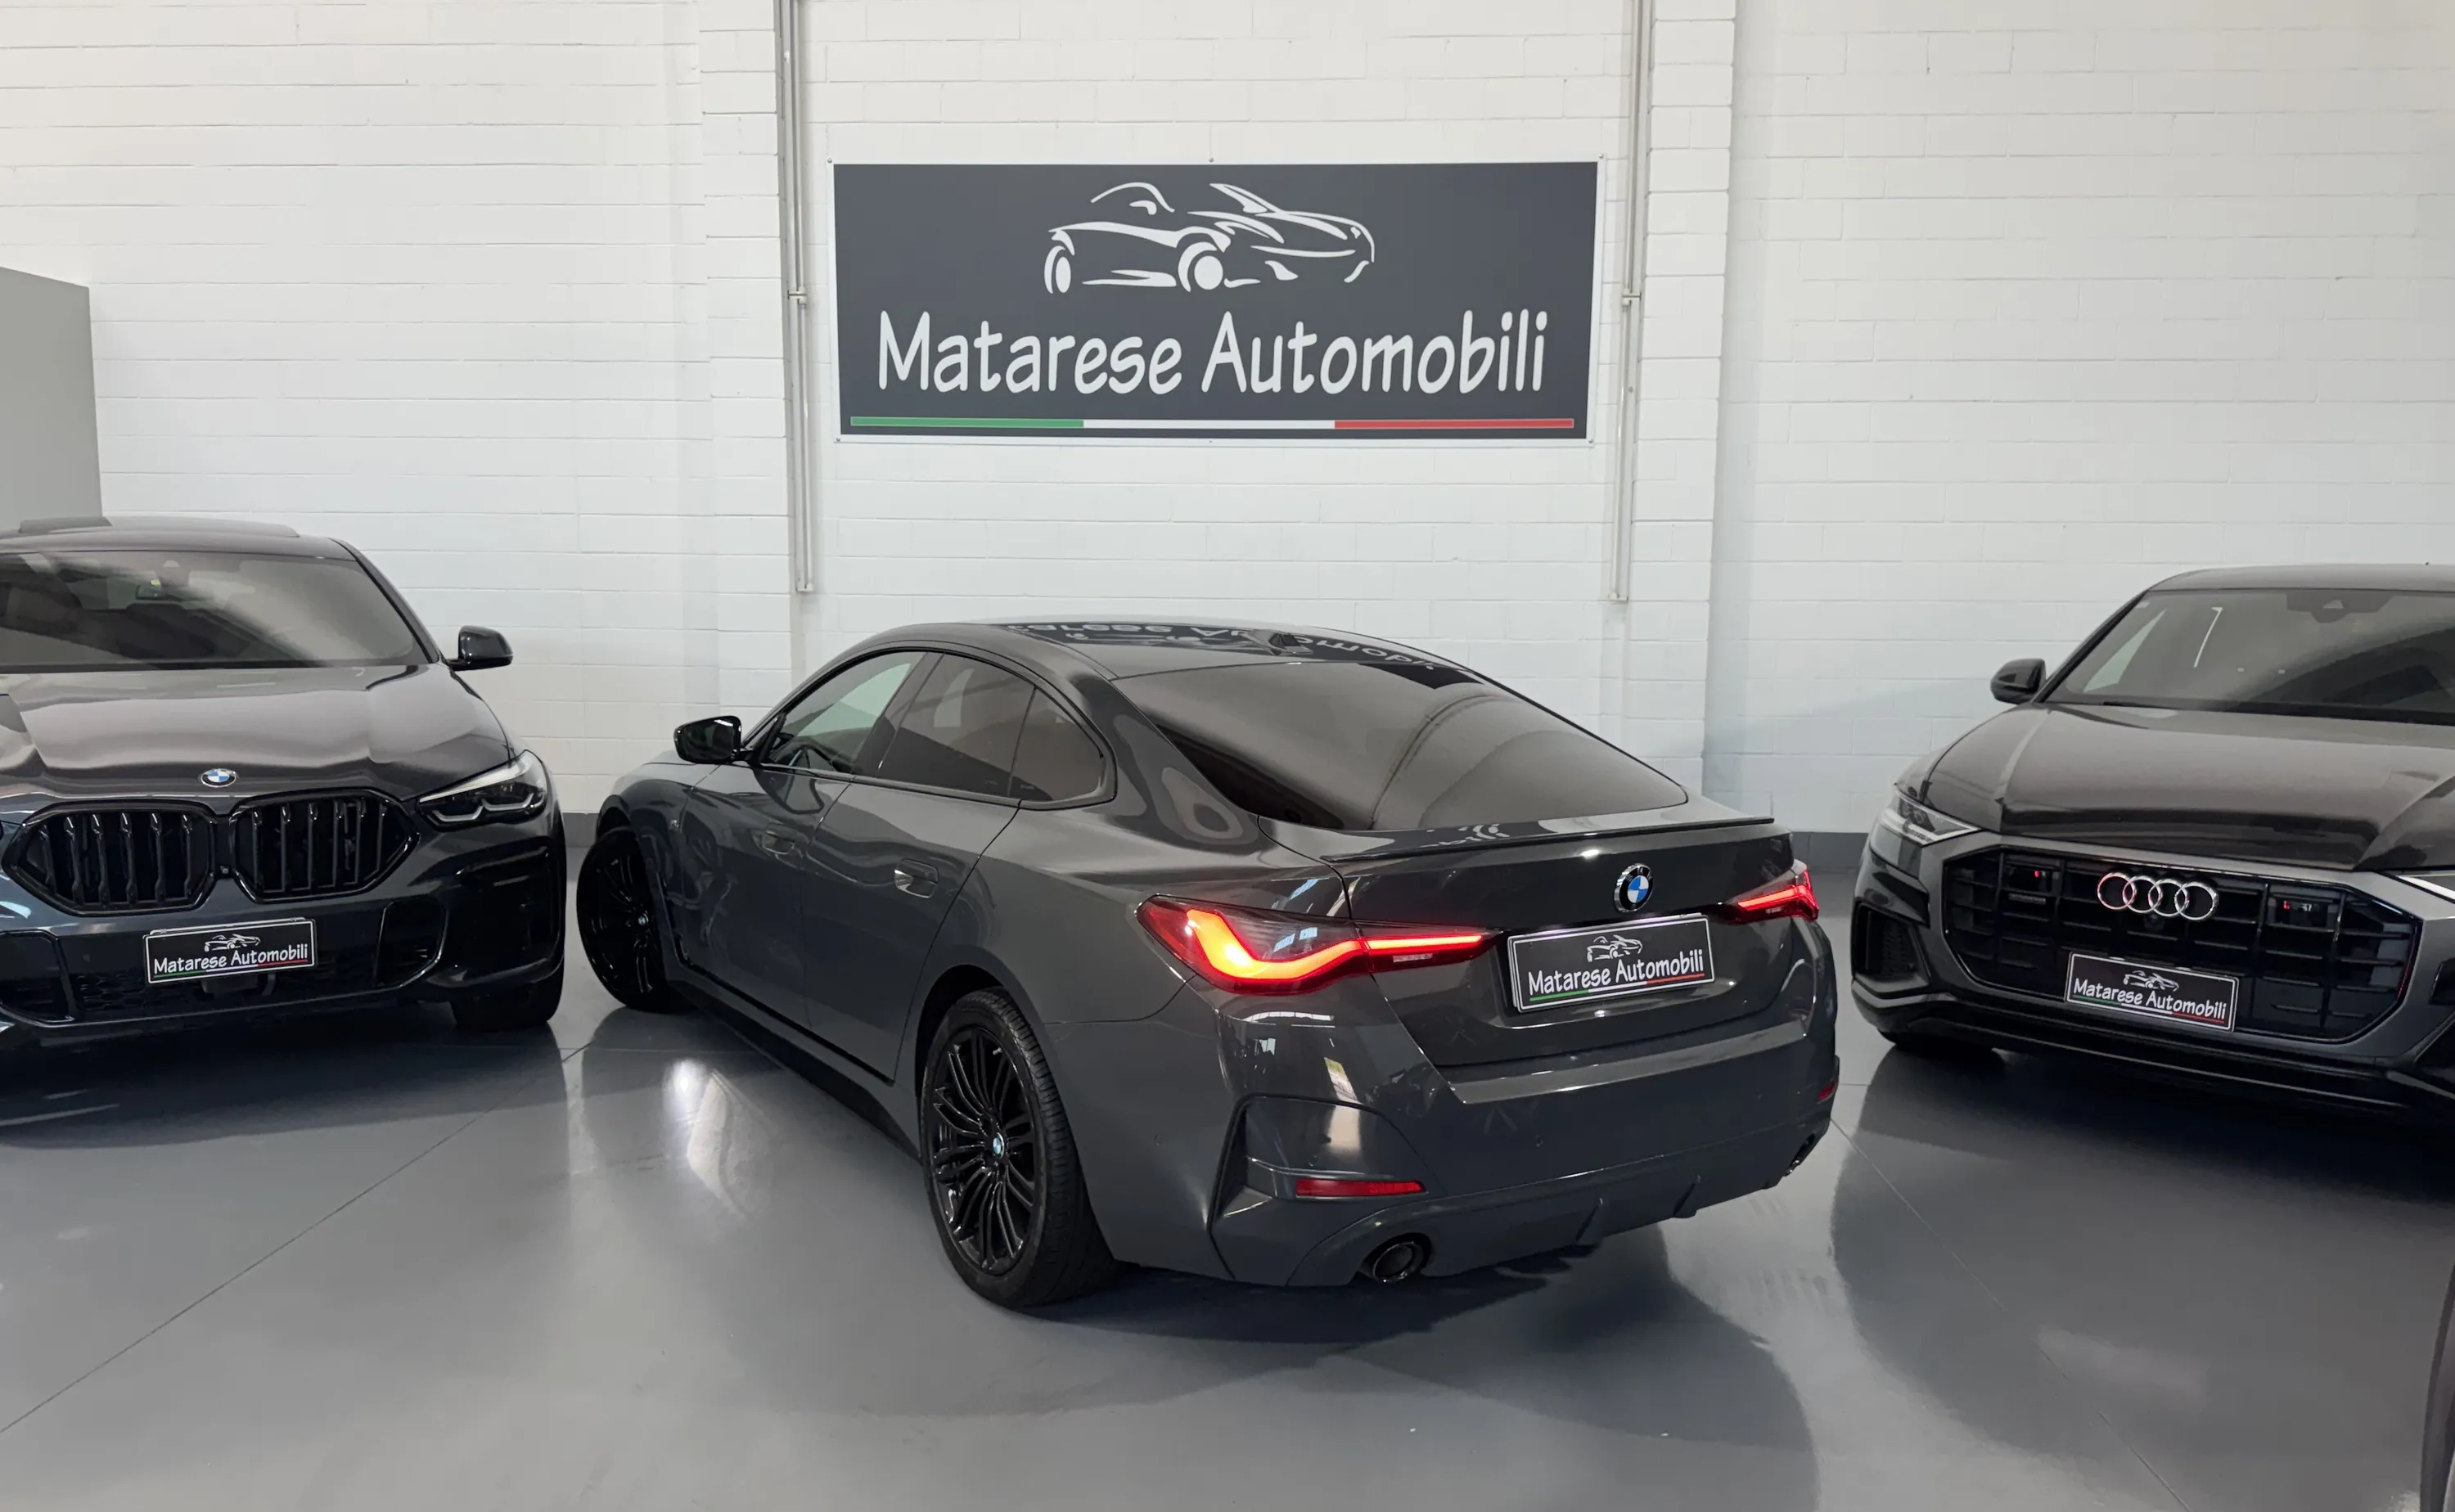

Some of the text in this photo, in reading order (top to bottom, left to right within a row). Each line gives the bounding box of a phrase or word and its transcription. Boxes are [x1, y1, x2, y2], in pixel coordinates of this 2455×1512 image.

[878, 308, 1547, 395] Matarese Automobili
[153, 943, 309, 974] Matarese Automobili
[1528, 948, 1704, 996] Matarese Automobili
[2073, 978, 2227, 1020] Matarese Automobili
